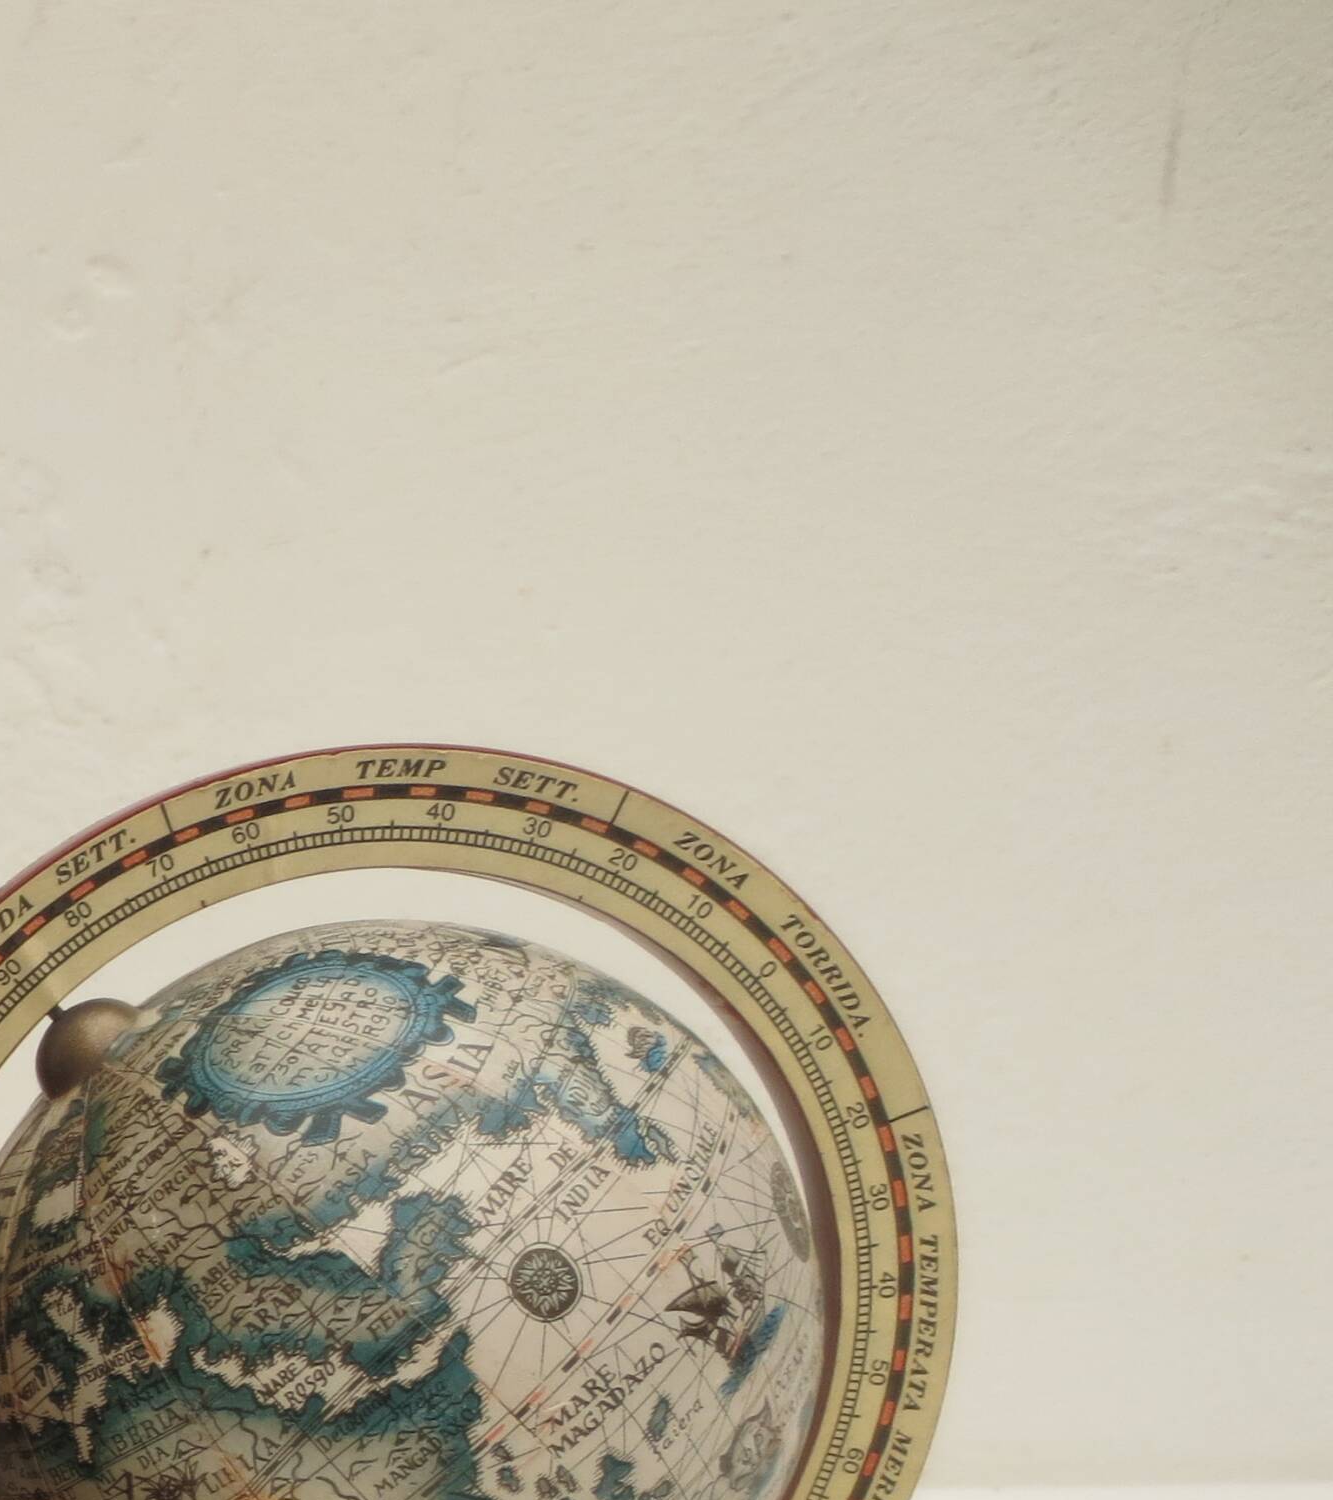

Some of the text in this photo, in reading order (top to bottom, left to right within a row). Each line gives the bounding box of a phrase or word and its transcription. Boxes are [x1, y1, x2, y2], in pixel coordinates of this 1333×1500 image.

[215, 758, 580, 810] ZONA TEMP SETT.
[327, 805, 355, 824] 50
[425, 802, 455, 822] 40
[232, 822, 260, 844] 60
[522, 817, 552, 839] 30
[55, 827, 138, 887] SETT.
[146, 854, 175, 878] 70
[608, 848, 638, 872] 20
[64, 901, 93, 928] 80
[687, 893, 714, 921] 10
[672, 831, 871, 1039] ZONA TORRIDA.
[760, 960, 777, 979] 0
[808, 1024, 833, 1052] 10
[845, 1102, 869, 1131] 20
[476, 1141, 578, 1227] MARE DE
[900, 1132, 937, 1213] ZONA
[556, 1163, 611, 1225] INDIA
[870, 1183, 889, 1212] 30
[878, 1272, 895, 1298] 40
[901, 1234, 938, 1413] TEMPERATA
[870, 1359, 889, 1386] 50
[548, 1364, 619, 1434] MARE
[550, 1342, 668, 1459] MAGADAZO
[842, 1448, 864, 1475] 60
